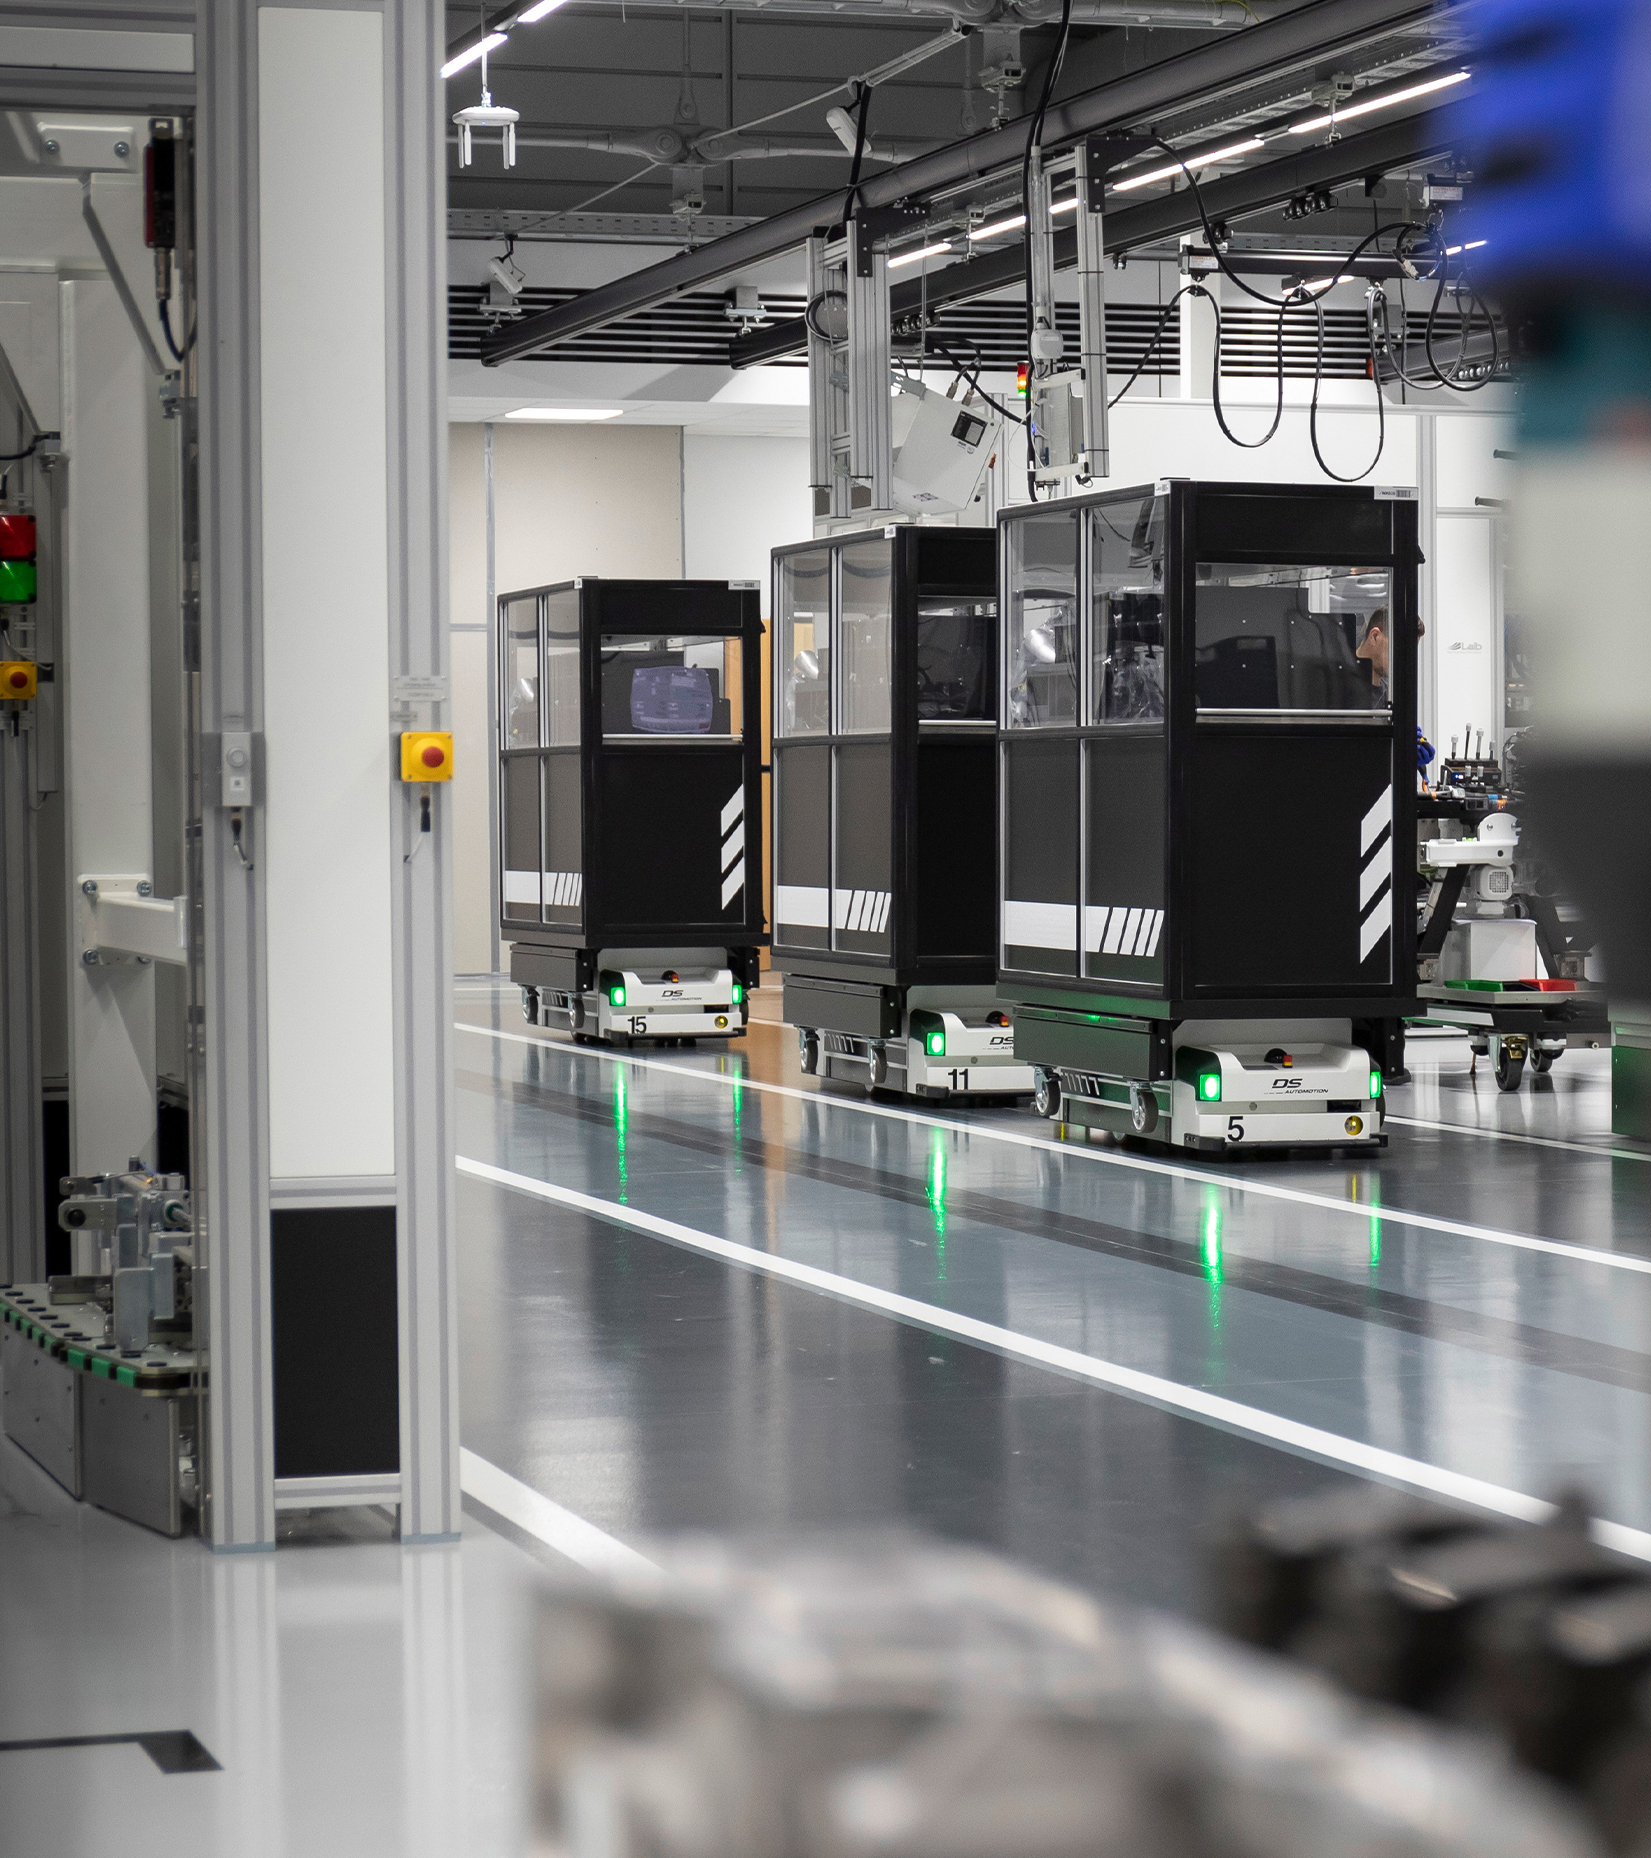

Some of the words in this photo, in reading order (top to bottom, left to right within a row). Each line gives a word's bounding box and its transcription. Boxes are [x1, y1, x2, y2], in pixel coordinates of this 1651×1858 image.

[628, 1016, 647, 1034] 15
[948, 1069, 968, 1090] 11
[1272, 1078, 1303, 1088] DS
[1227, 1115, 1245, 1142] 5
